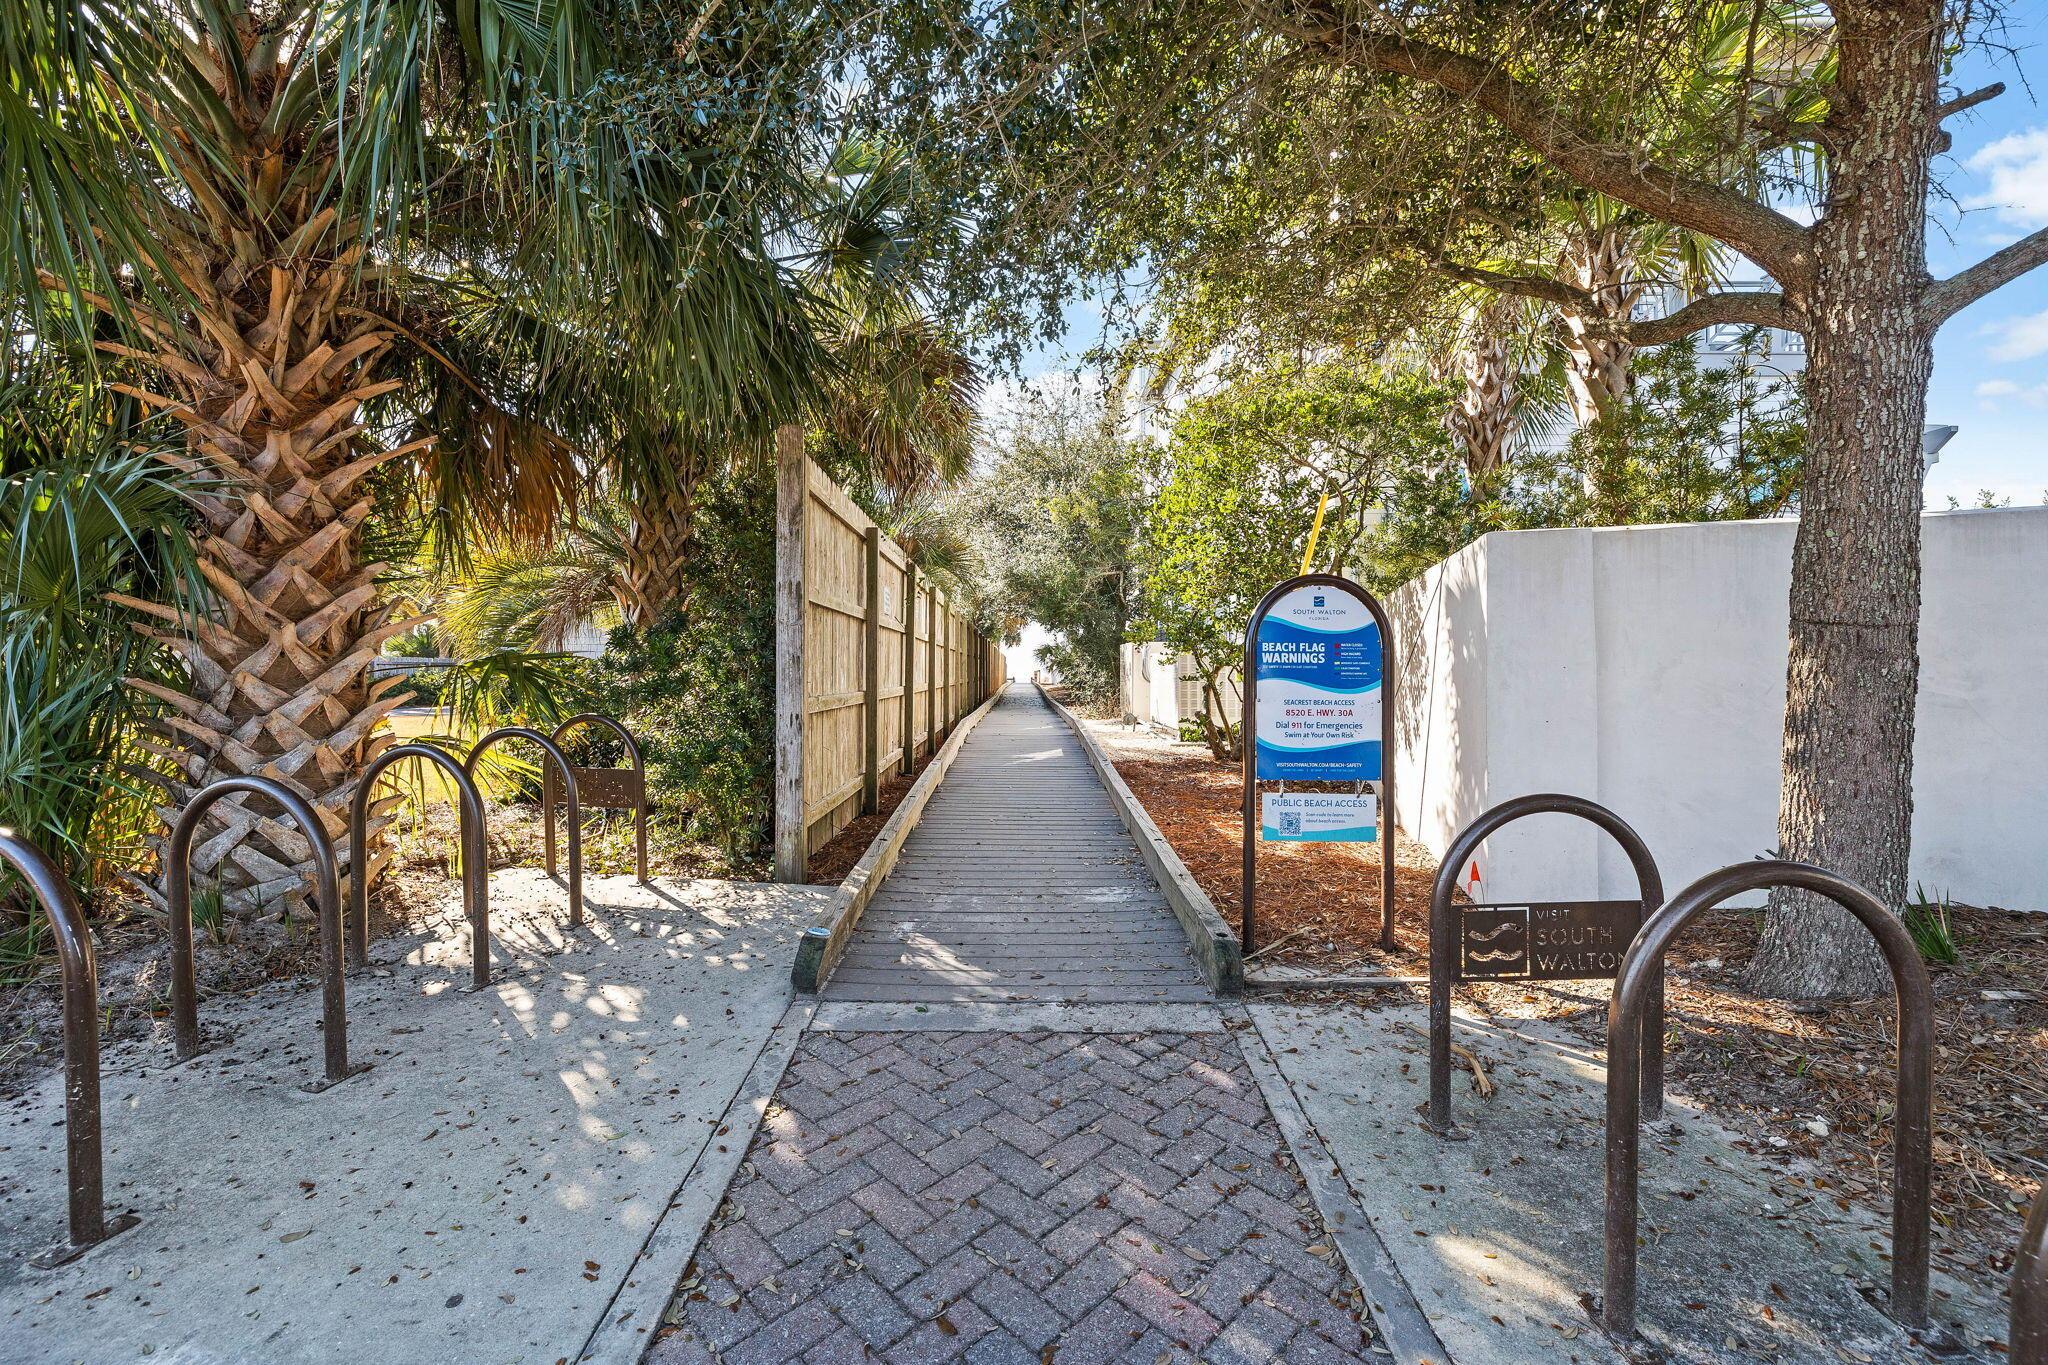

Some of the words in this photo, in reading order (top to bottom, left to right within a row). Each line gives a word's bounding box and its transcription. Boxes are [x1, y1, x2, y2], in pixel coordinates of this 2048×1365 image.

[1262, 642, 1296, 652] BEACH
[1300, 642, 1326, 652] FLAG
[1262, 652, 1326, 664] WARNINGS
[1316, 722, 1362, 731] Emergencies
[1536, 910, 1570, 921] VISIT
[1537, 927, 1613, 946] SOUTH
